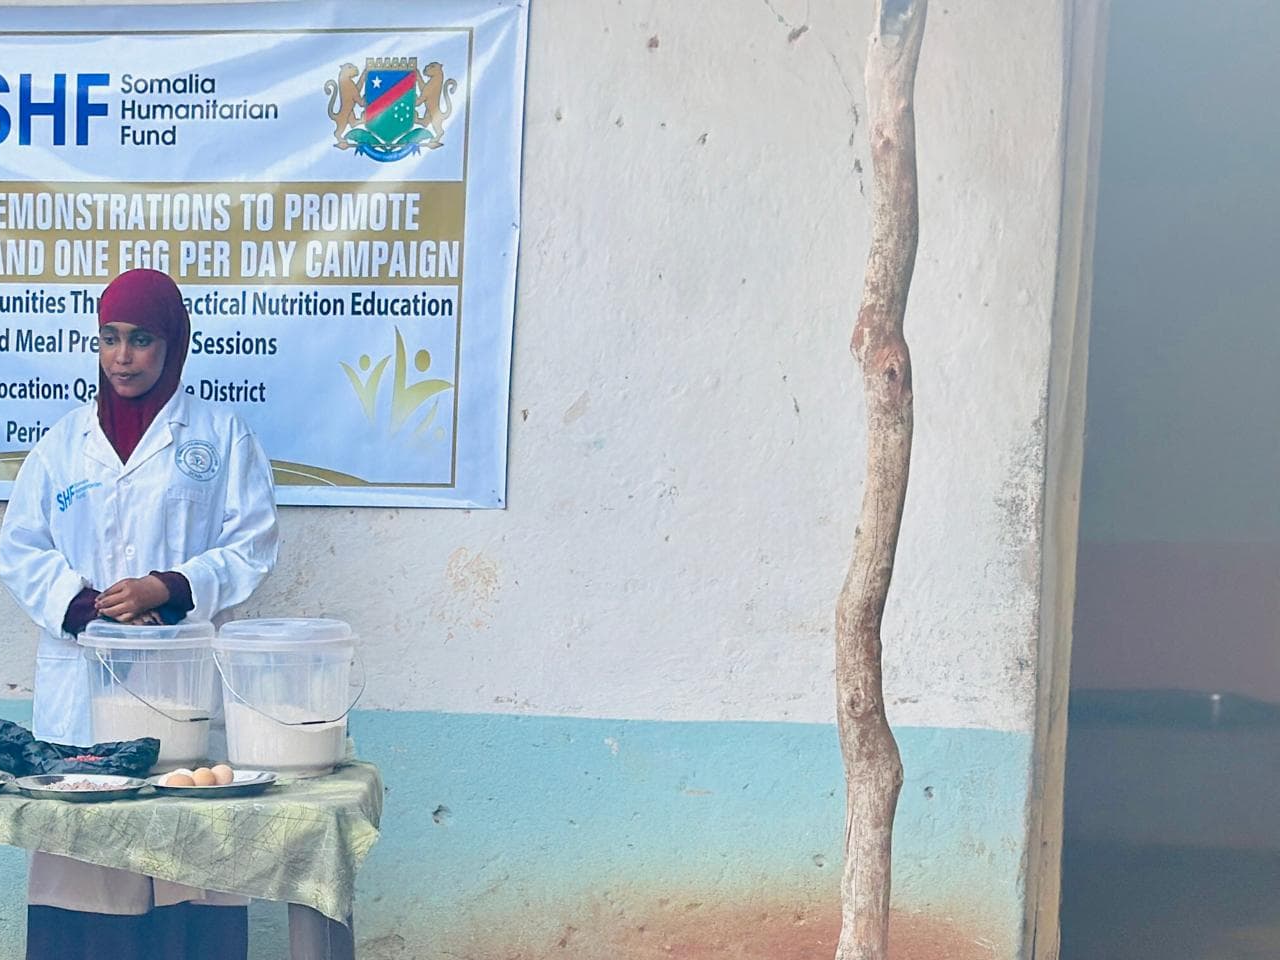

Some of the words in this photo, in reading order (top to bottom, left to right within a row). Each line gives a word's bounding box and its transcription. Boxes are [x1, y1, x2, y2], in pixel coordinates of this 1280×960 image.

[121, 74, 216, 94] Somalia
[121, 100, 279, 120] Humanitarian
[121, 126, 177, 146] Fund
[240, 193, 277, 231] TO
[284, 192, 420, 231] PROMOTE
[54, 239, 109, 277] ONE
[119, 239, 170, 275] EGG
[180, 240, 230, 278] PER
[240, 239, 299, 278] DAY
[305, 239, 459, 278] CAMPAIGN
[183, 290, 247, 316] actical
[252, 291, 344, 316] Nutrition
[351, 291, 453, 317] Education
[15, 328, 63, 353] Meal
[69, 329, 100, 354] Pre
[191, 330, 277, 356] Sessions
[73, 378, 98, 403] Qa
[200, 379, 266, 403] District
[6, 420, 51, 443] Peri
[56, 484, 75, 512] SHF
